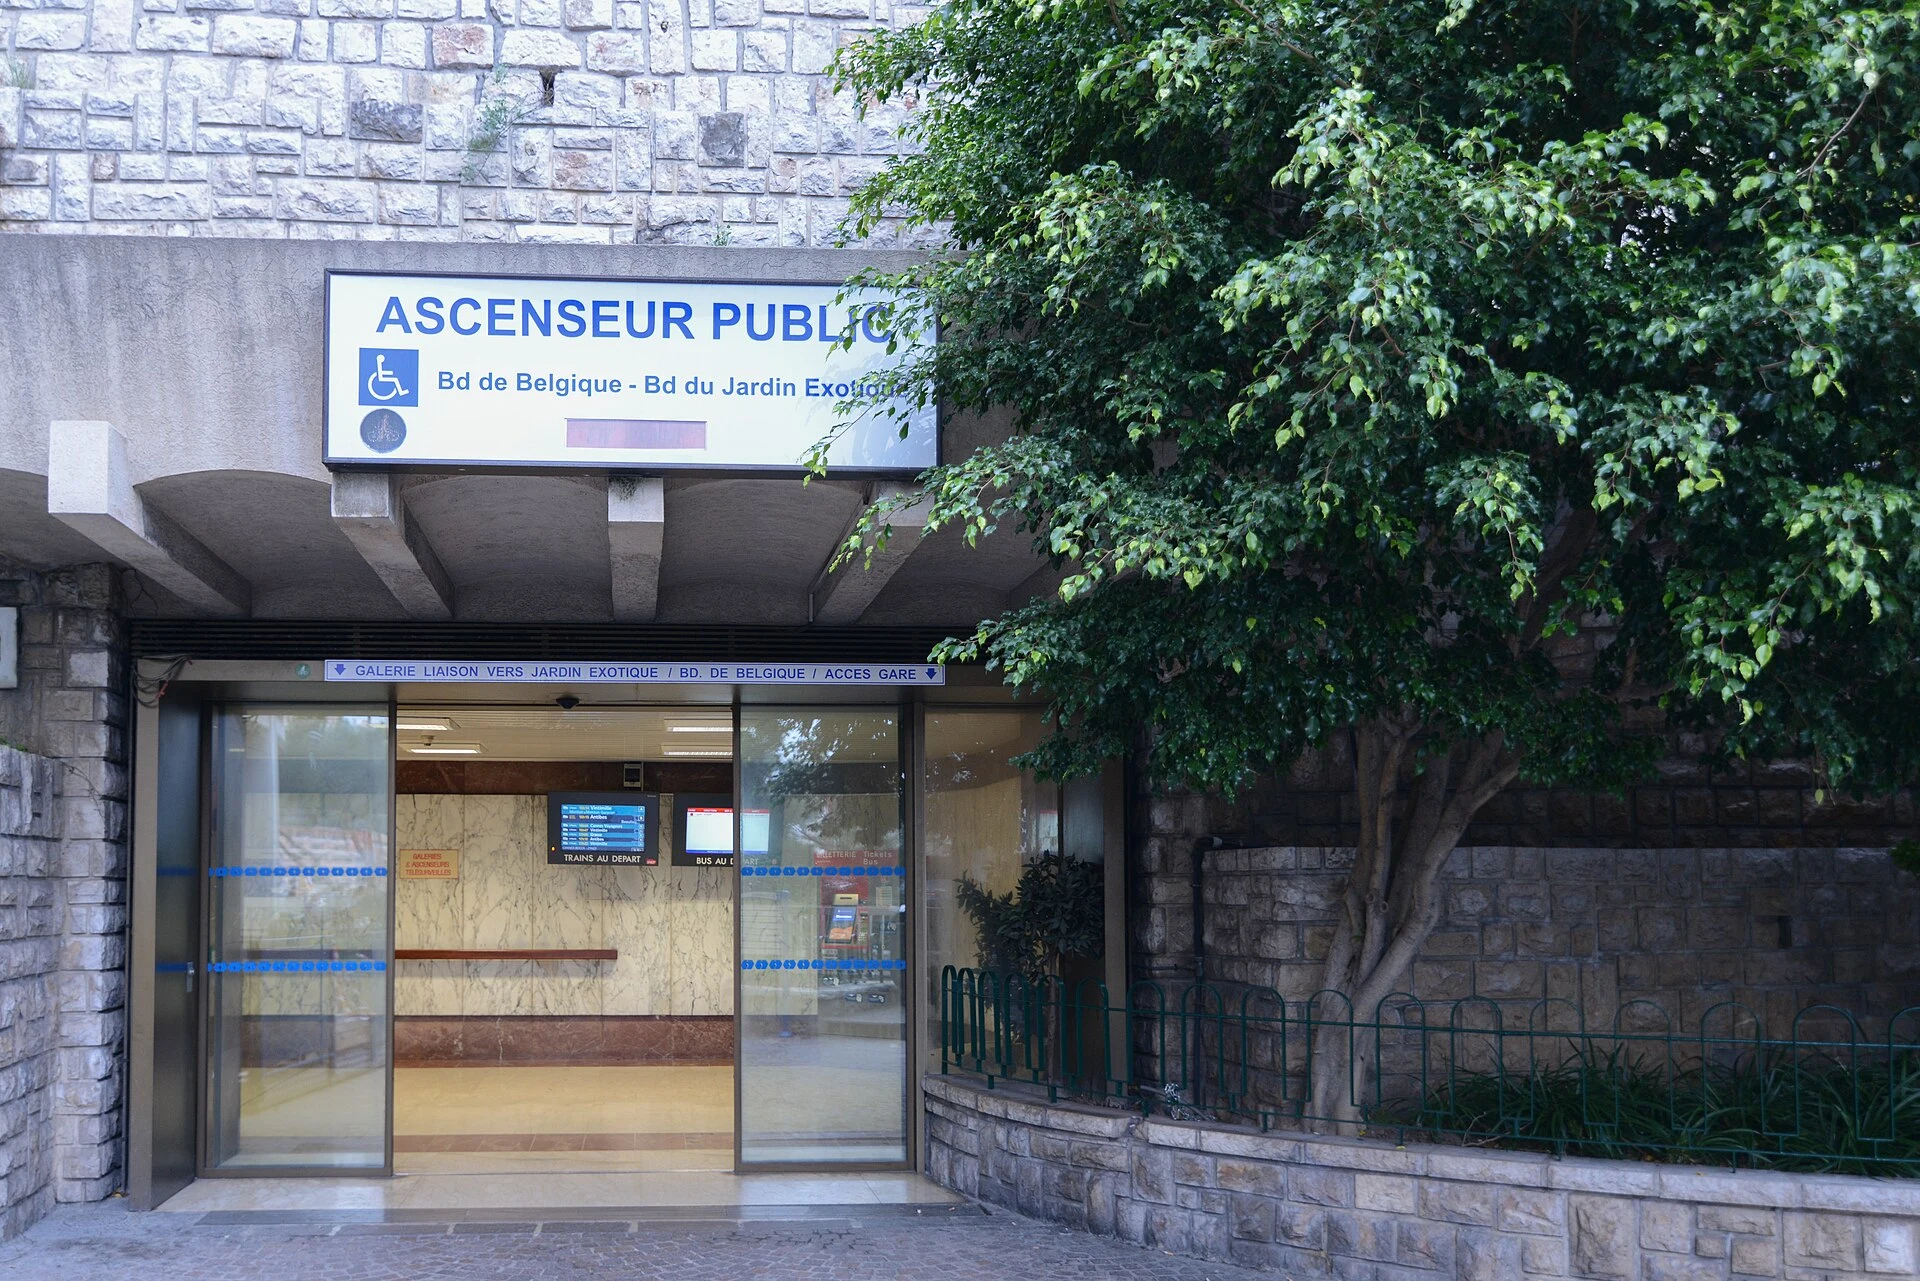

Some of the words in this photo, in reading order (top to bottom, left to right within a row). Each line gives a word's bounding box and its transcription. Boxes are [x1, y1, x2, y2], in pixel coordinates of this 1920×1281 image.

[376, 296, 695, 339] ASCENSEUR
[712, 302, 893, 344] PUBLIC
[438, 371, 470, 391] Bd
[479, 372, 507, 391] de
[516, 372, 622, 397] Belgique
[644, 375, 676, 394] Bd
[684, 376, 714, 395] du
[722, 376, 796, 397] Jardin
[355, 665, 416, 677] GALERIE
[424, 665, 478, 677] LIAISON
[487, 665, 524, 677] VERS
[531, 666, 581, 678] JARDIN
[589, 666, 658, 678] EXOTIQUE
[667, 667, 673, 678] /
[680, 667, 702, 679] BD.
[710, 667, 728, 679] DE
[736, 668, 805, 679] BELGIQUE
[812, 668, 817, 679] /
[824, 668, 871, 680] ACCES
[878, 668, 916, 680] GARE
[564, 854, 594, 863] TRAINS
[597, 854, 609, 863] AU
[612, 855, 641, 864] DEPART
[863, 850, 893, 858] Tickets
[696, 857, 712, 865] BUS
[715, 857, 727, 865] AU
